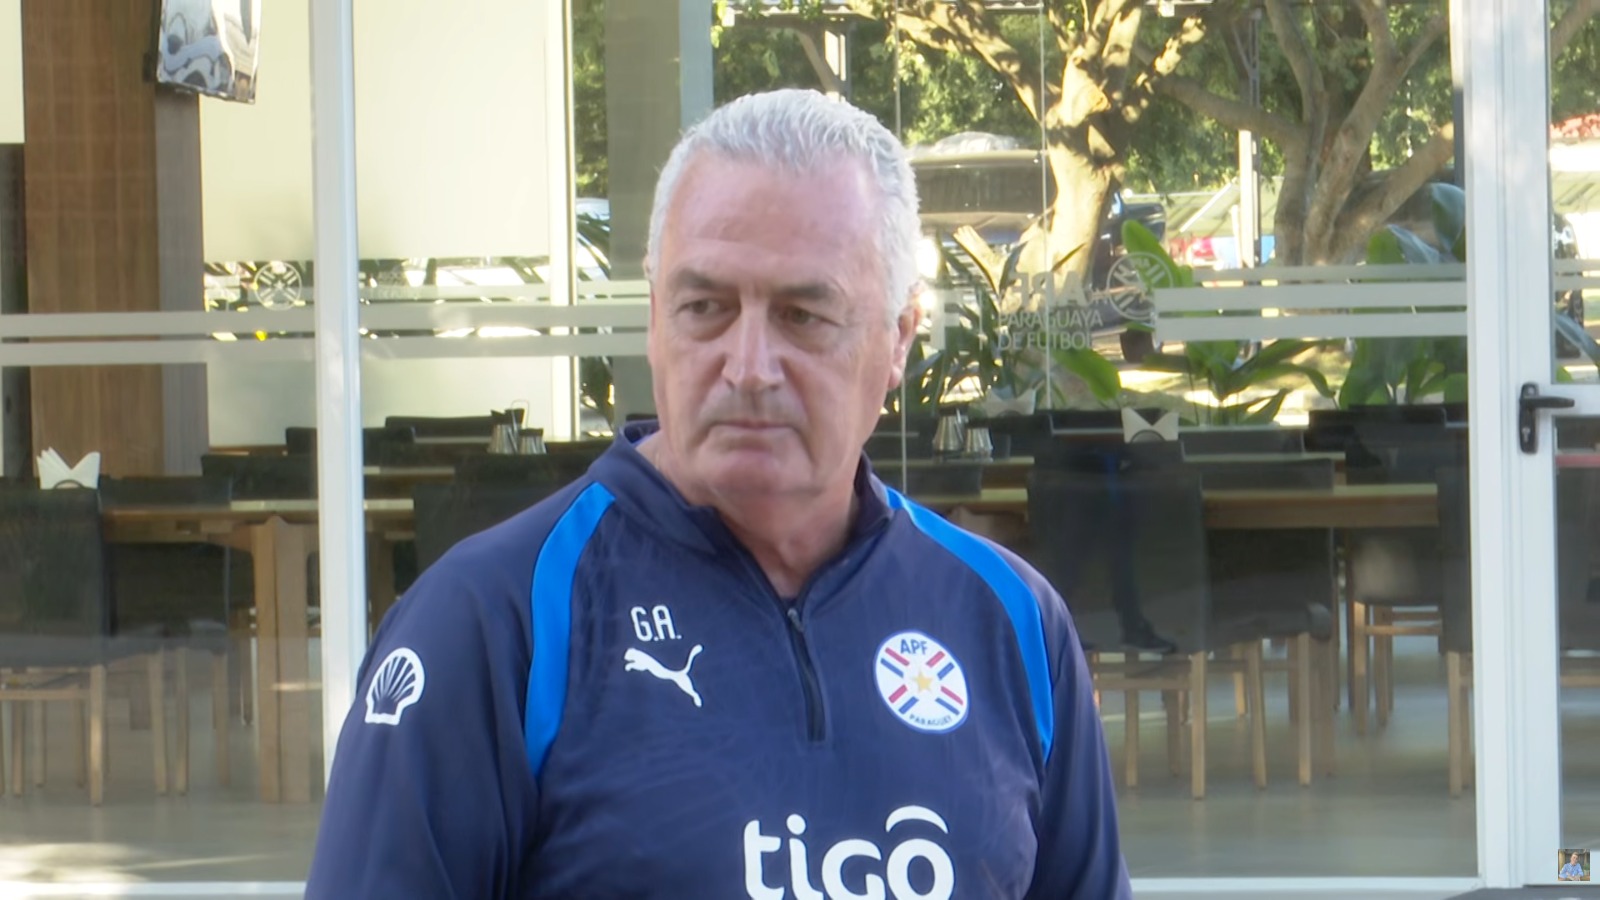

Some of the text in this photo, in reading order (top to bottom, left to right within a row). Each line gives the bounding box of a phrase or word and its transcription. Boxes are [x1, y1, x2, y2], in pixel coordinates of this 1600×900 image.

[998, 309, 1103, 328] PARAGUAYA
[998, 332, 1022, 350] DE
[631, 604, 682, 641] G.A.
[900, 638, 928, 655] APF
